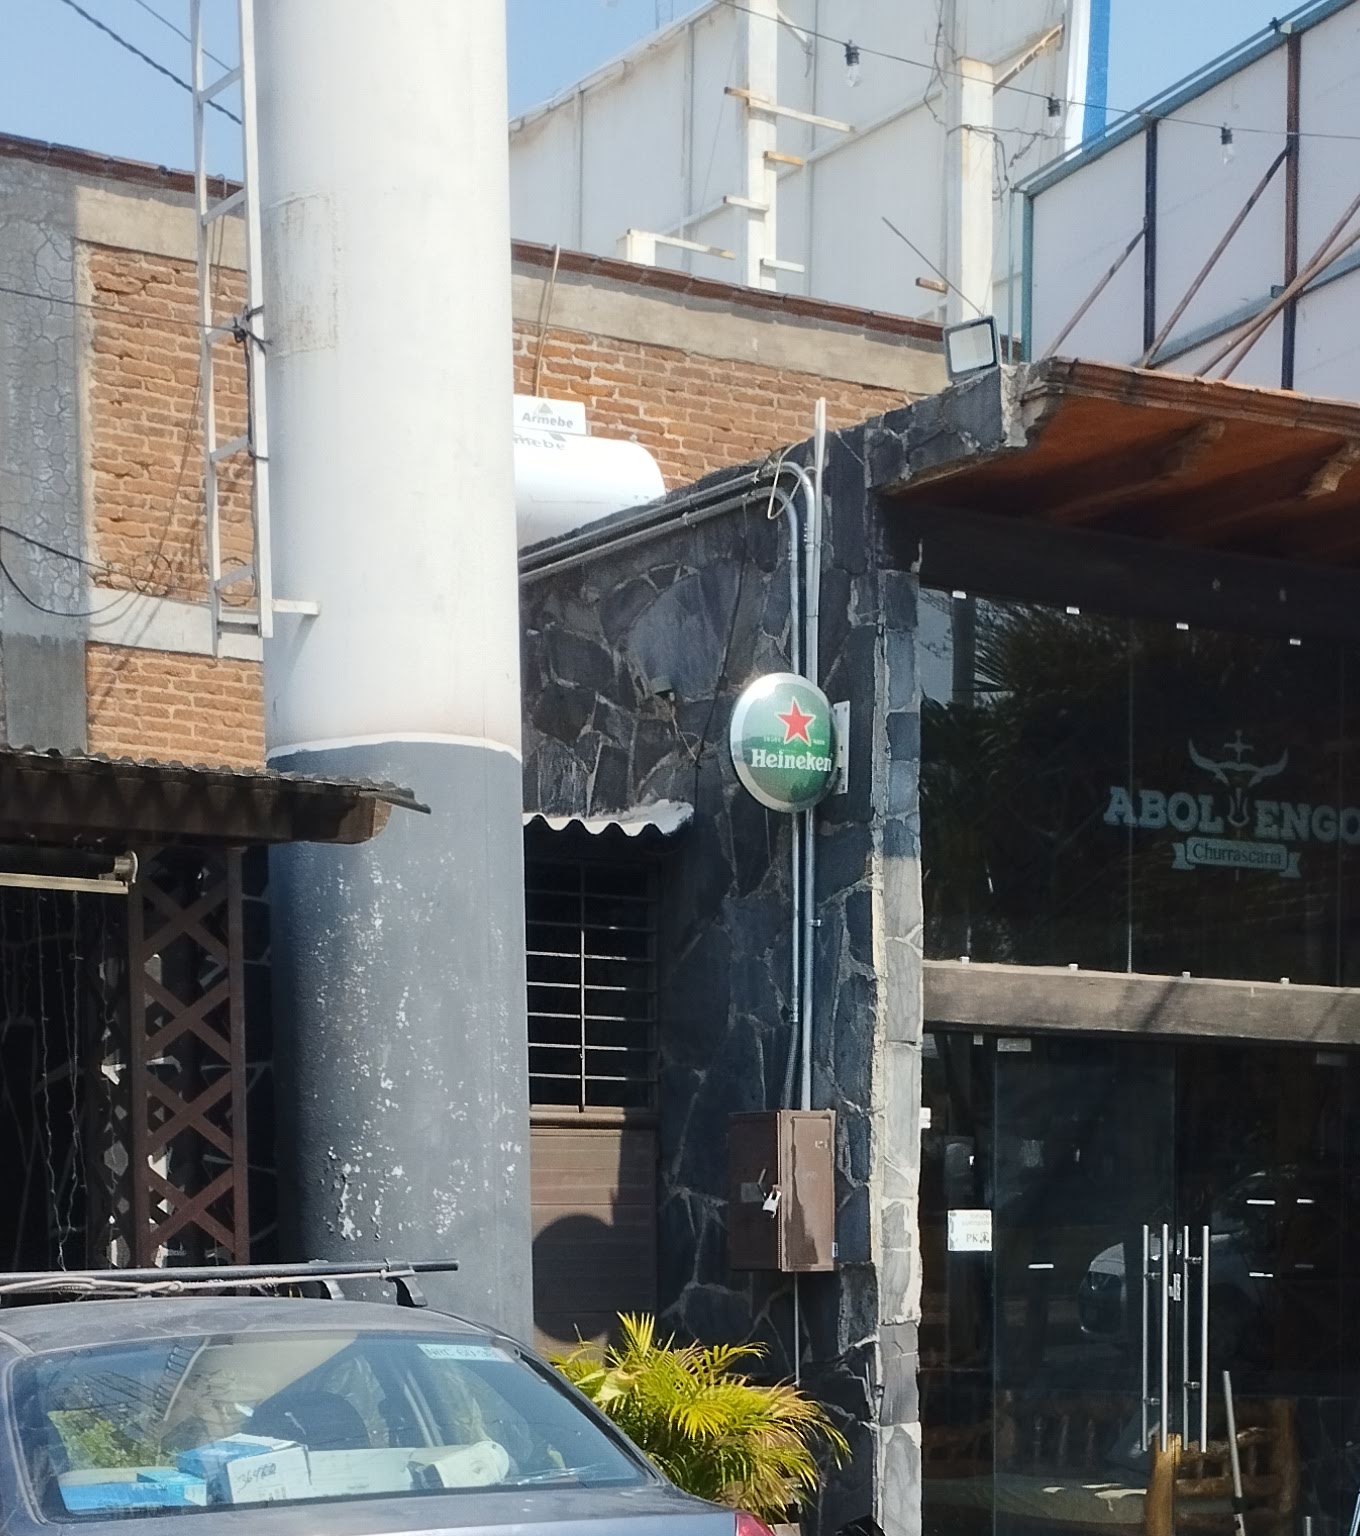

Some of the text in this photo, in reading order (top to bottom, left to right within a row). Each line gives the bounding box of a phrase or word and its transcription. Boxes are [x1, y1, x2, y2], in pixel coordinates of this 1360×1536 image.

[521, 412, 574, 429] Armebe
[513, 432, 566, 450] mebe
[751, 748, 832, 771] Heineken
